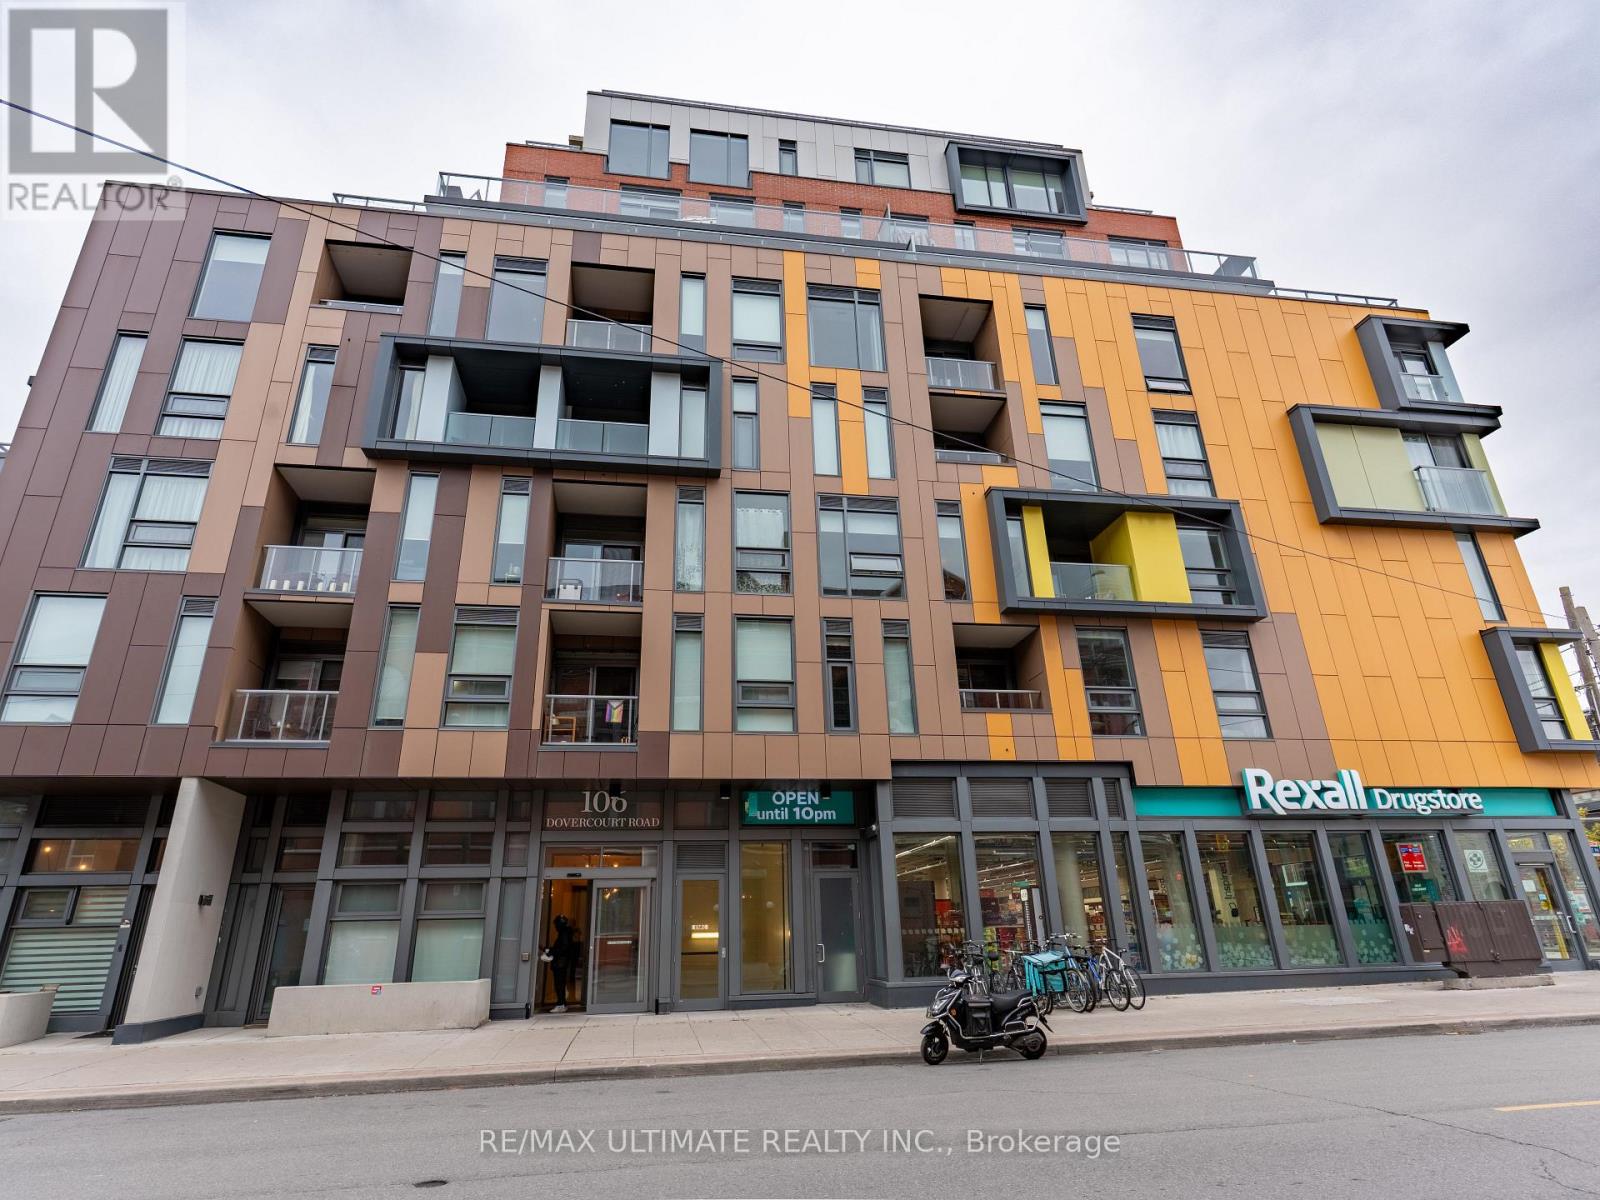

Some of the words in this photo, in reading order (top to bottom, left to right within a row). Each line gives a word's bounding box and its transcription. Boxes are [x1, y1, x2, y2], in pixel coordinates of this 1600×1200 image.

[772, 791, 819, 805] OPEN
[1242, 768, 1368, 815] Rexall
[1372, 788, 1483, 815] Drugstore
[546, 817, 626, 828] DOVERCOURT
[628, 817, 660, 828] ROAD
[756, 807, 789, 820] until
[793, 807, 836, 823] 10pm
